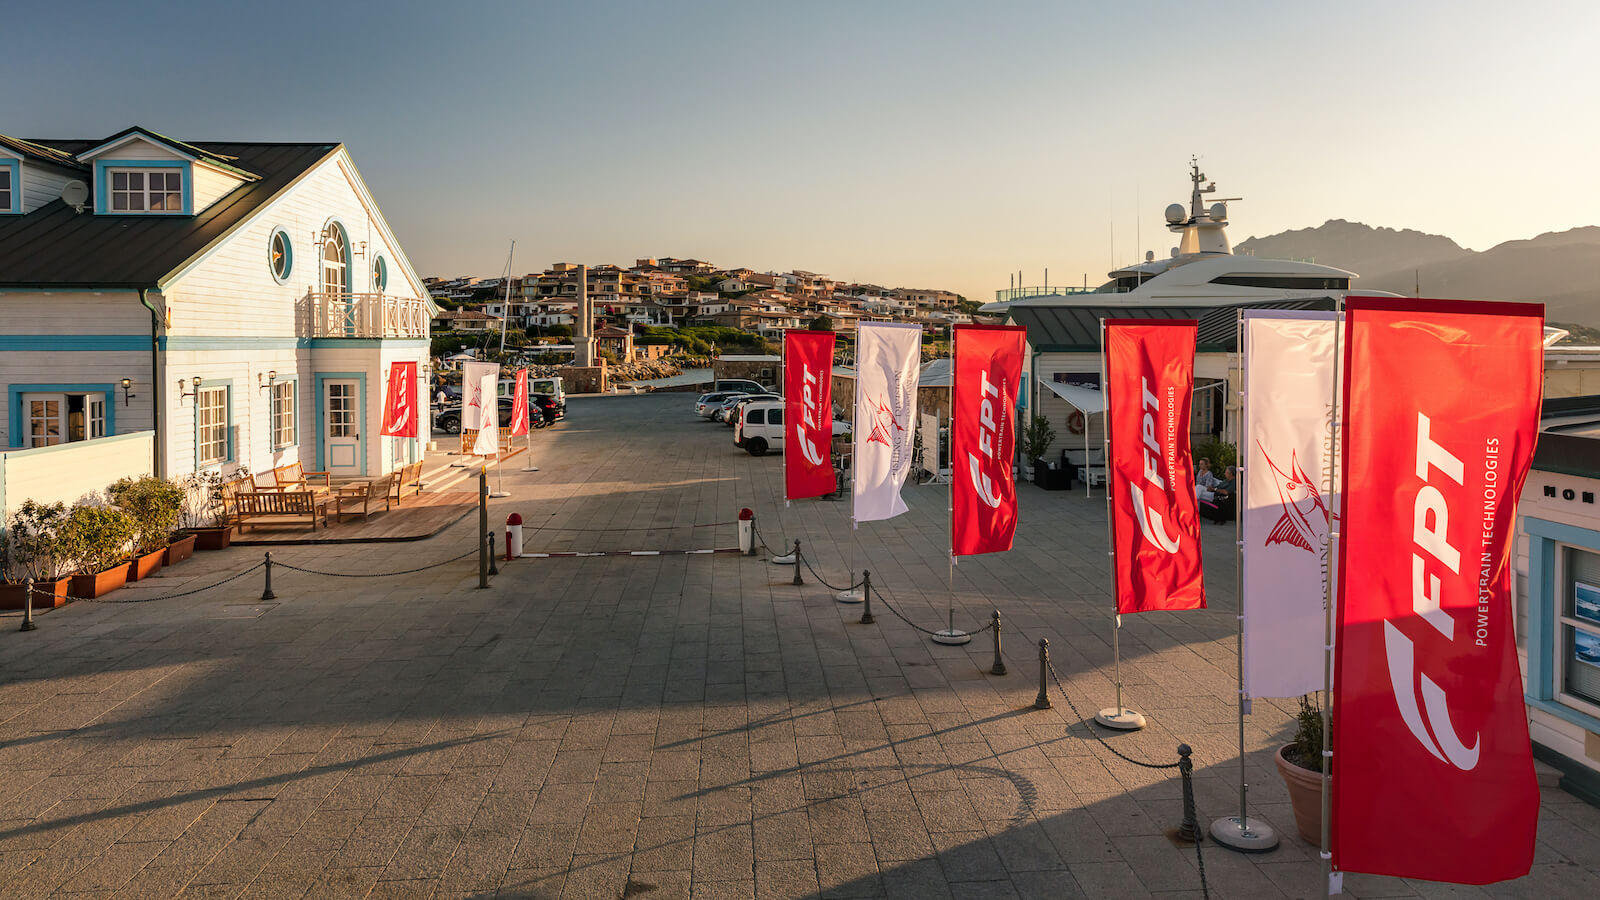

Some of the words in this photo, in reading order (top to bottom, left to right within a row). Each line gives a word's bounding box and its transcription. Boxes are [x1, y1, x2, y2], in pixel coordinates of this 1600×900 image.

[803, 363, 817, 430] FPT
[979, 369, 999, 459] FPT
[997, 422, 1005, 460] POWERTRAIN
[1142, 375, 1164, 491] FPT
[1167, 386, 1175, 440] TECHNOLOGIES
[1168, 443, 1176, 492] POWERTRAIN
[1481, 437, 1499, 548] TECHNOLOGIES
[1412, 411, 1465, 642] FPT
[1475, 552, 1492, 647] POWERTRAIN
